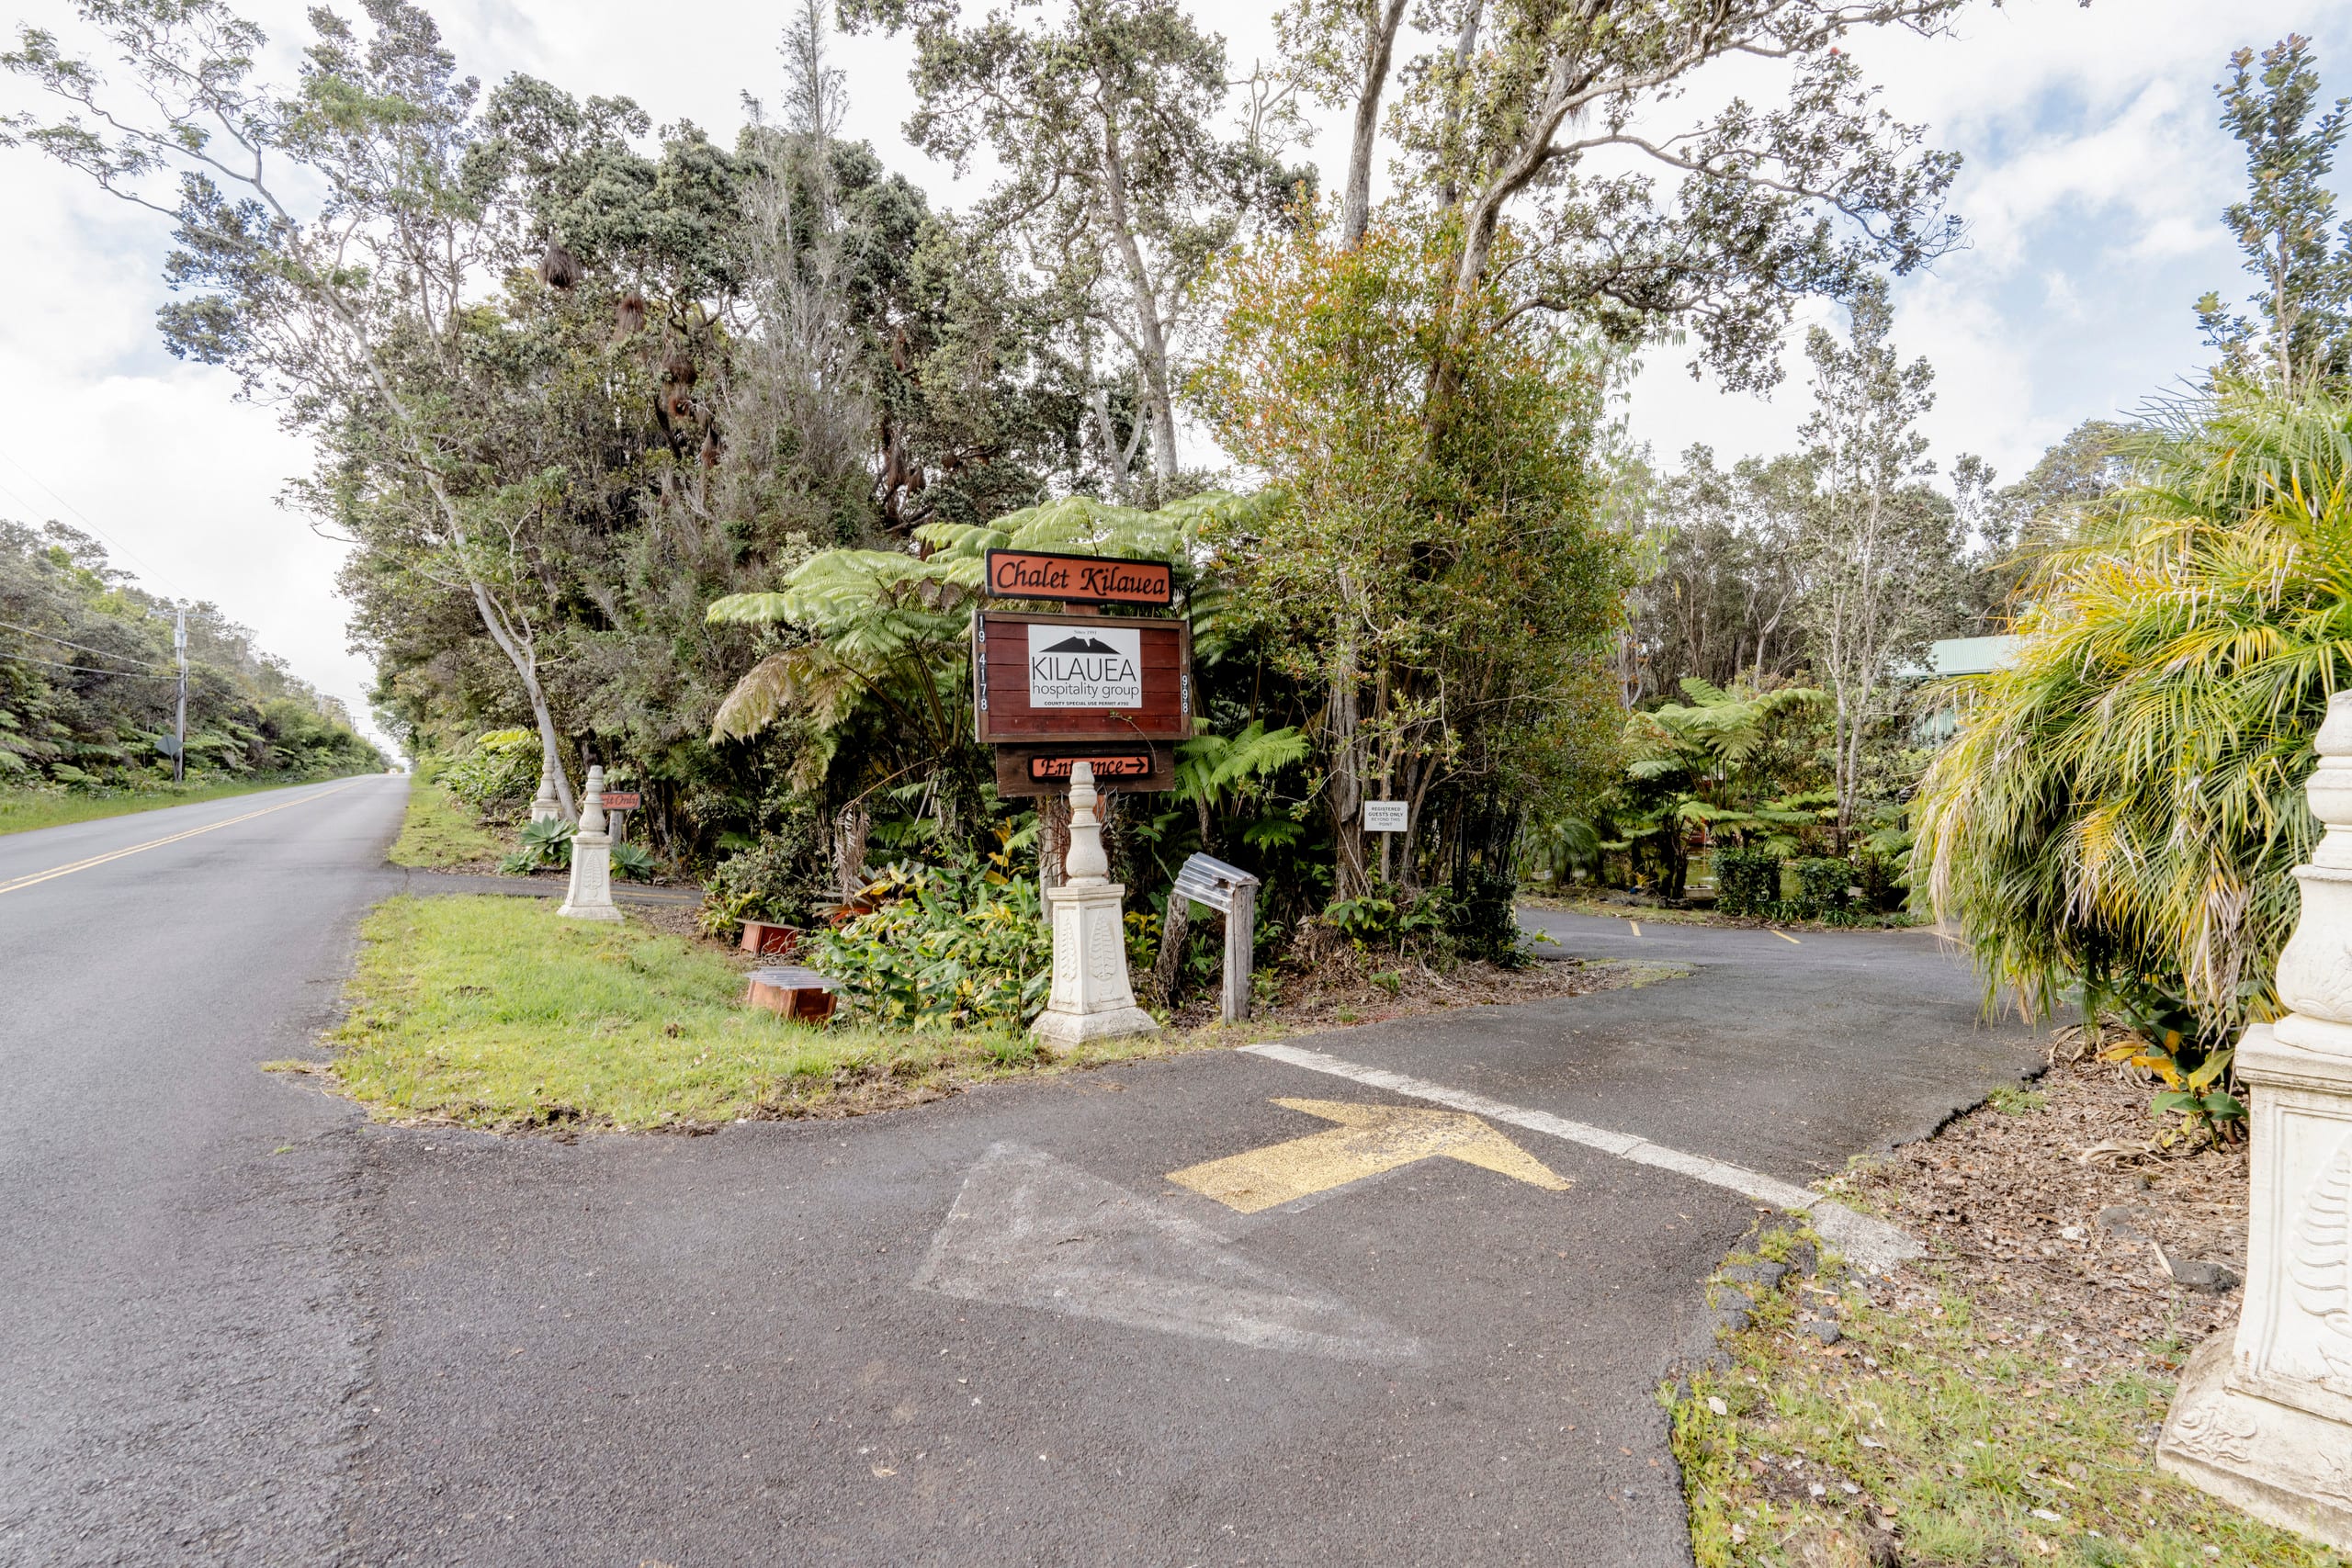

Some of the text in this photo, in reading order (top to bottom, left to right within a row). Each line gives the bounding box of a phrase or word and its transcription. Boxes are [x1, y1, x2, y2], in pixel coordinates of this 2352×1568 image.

[997, 559, 1166, 596] Chalet Kilauea
[1032, 656, 1136, 682] KILAUEA
[1032, 681, 1139, 699] hospitality group
[616, 794, 639, 807] Only
